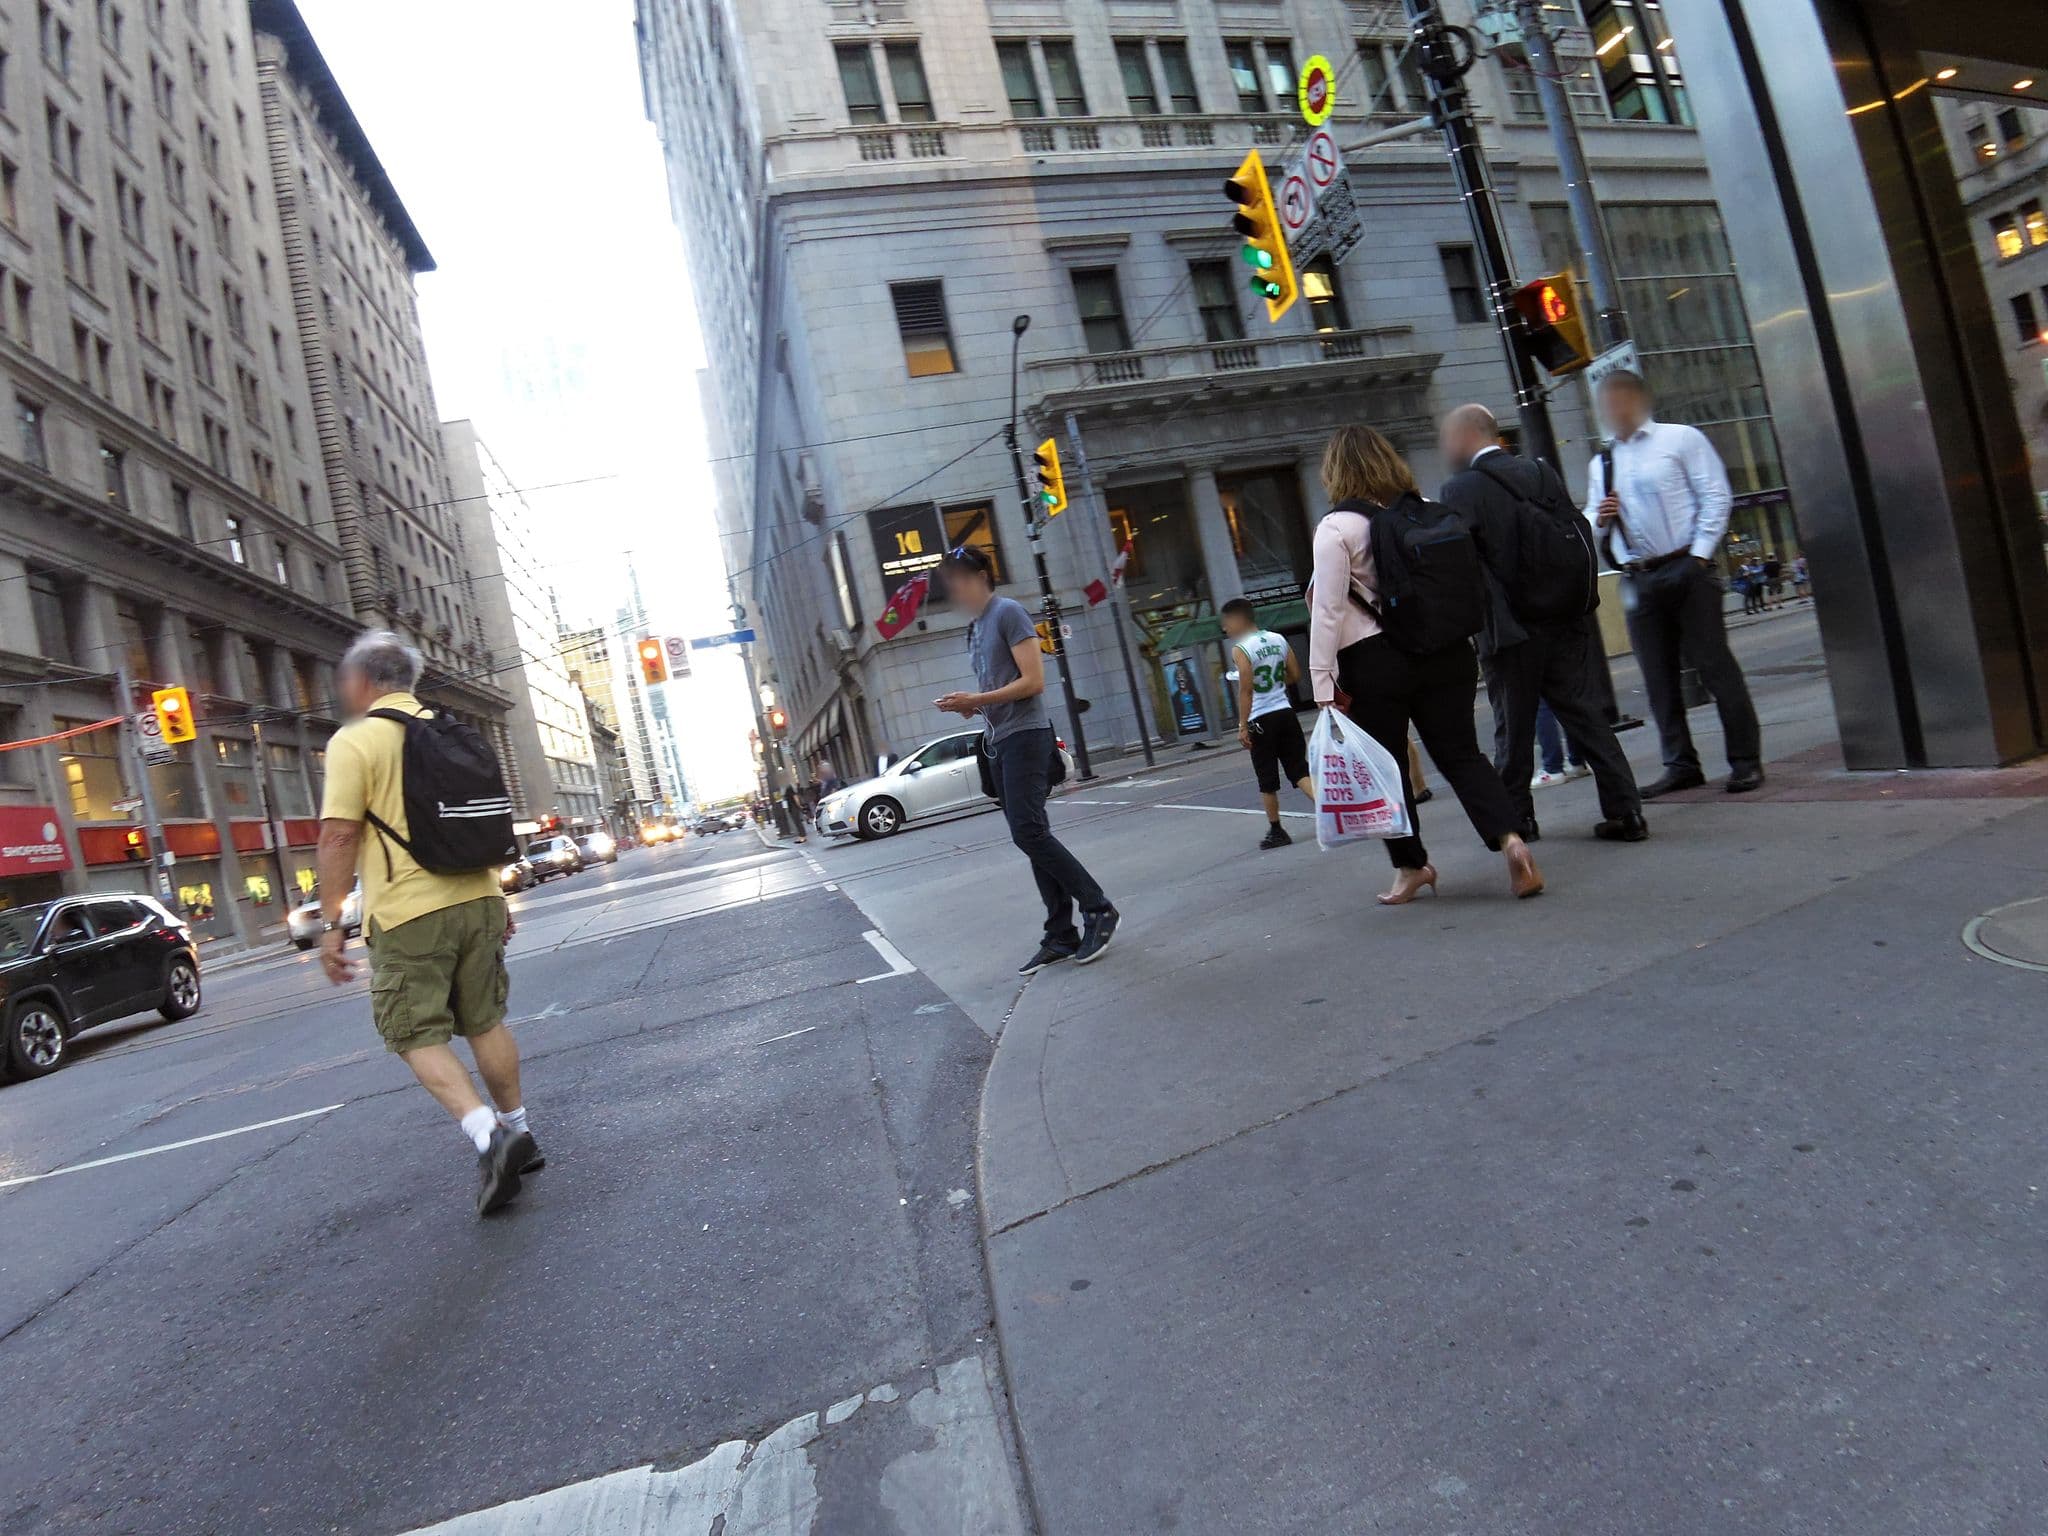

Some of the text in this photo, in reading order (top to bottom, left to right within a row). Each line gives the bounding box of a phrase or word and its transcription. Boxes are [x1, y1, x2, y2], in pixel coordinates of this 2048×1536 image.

[1252, 660, 1286, 693] 34
[1324, 754, 1346, 768] TOS
[1324, 787, 1354, 801] TOYS
